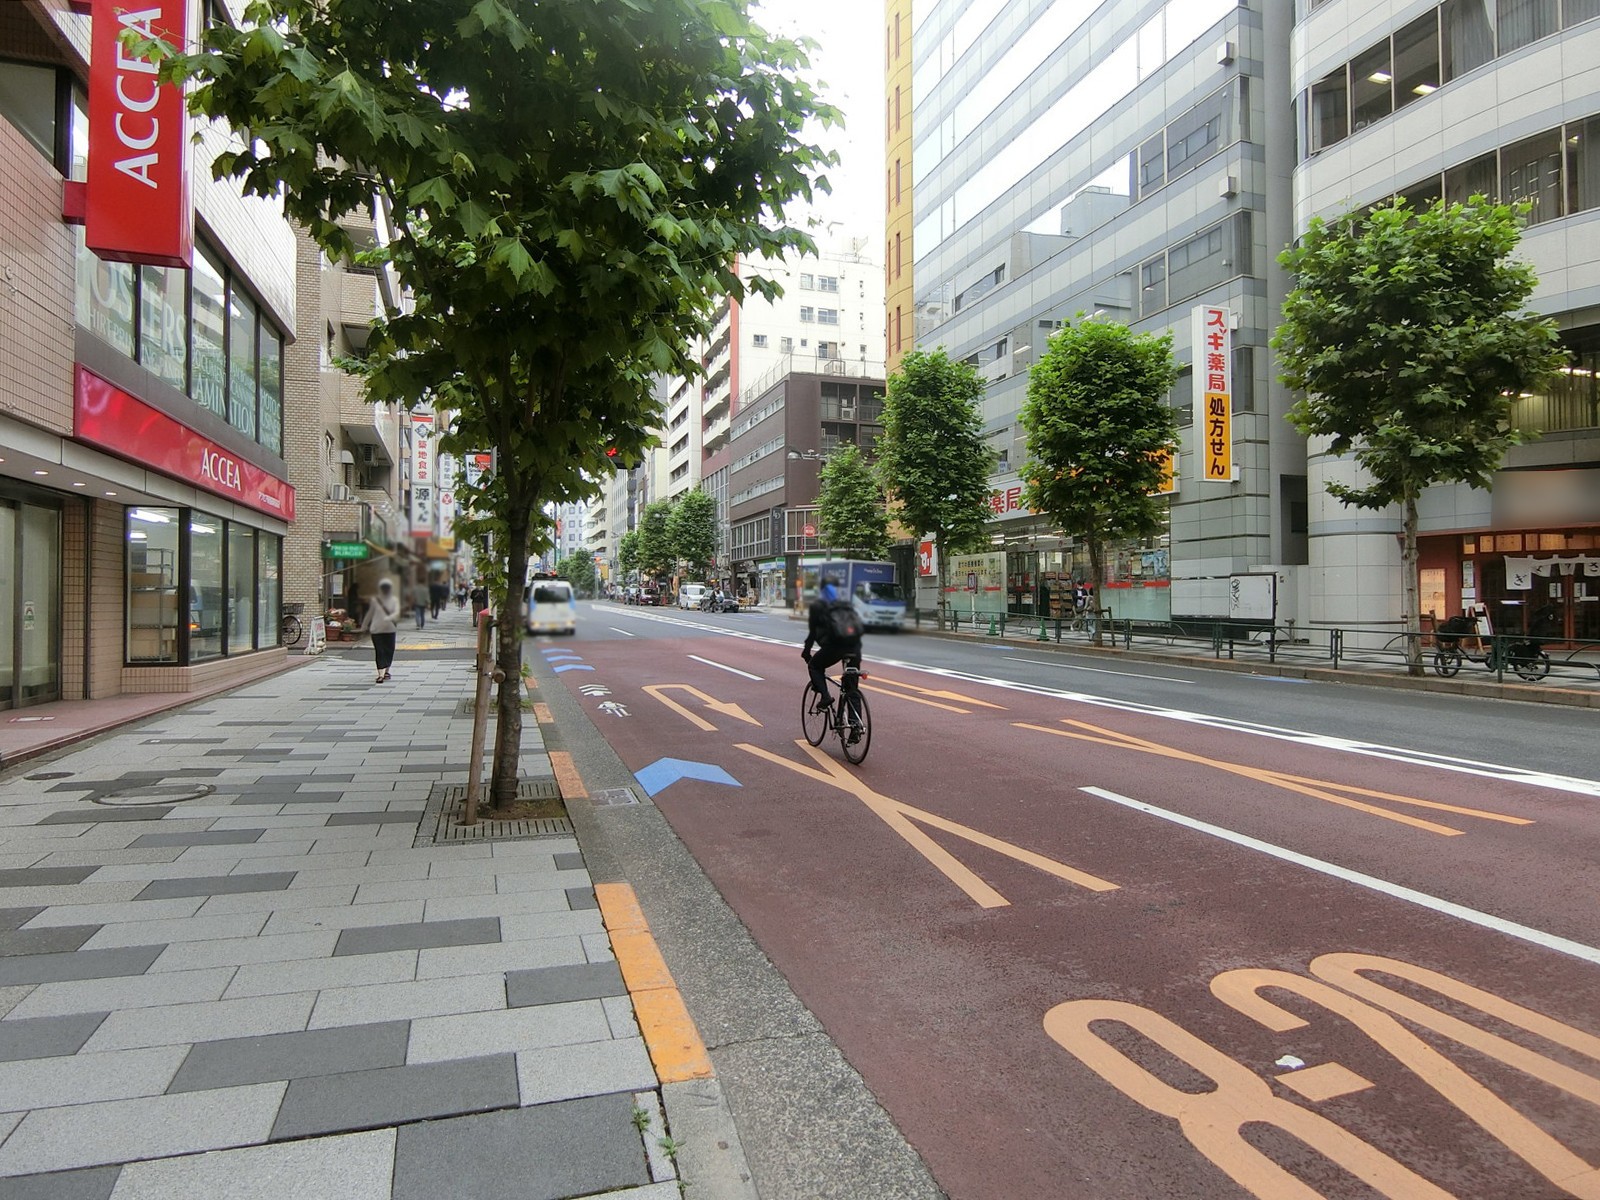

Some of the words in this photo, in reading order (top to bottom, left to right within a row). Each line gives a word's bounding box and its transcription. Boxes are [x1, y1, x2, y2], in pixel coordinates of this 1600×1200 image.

[114, 7, 163, 190] ACCEA
[1207, 309, 1228, 392] スギ薬局
[417, 440, 428, 480] 築地食堂
[1209, 396, 1226, 477] 処方せん
[201, 447, 241, 491] ACCEA
[415, 487, 430, 523] 源ちゃん
